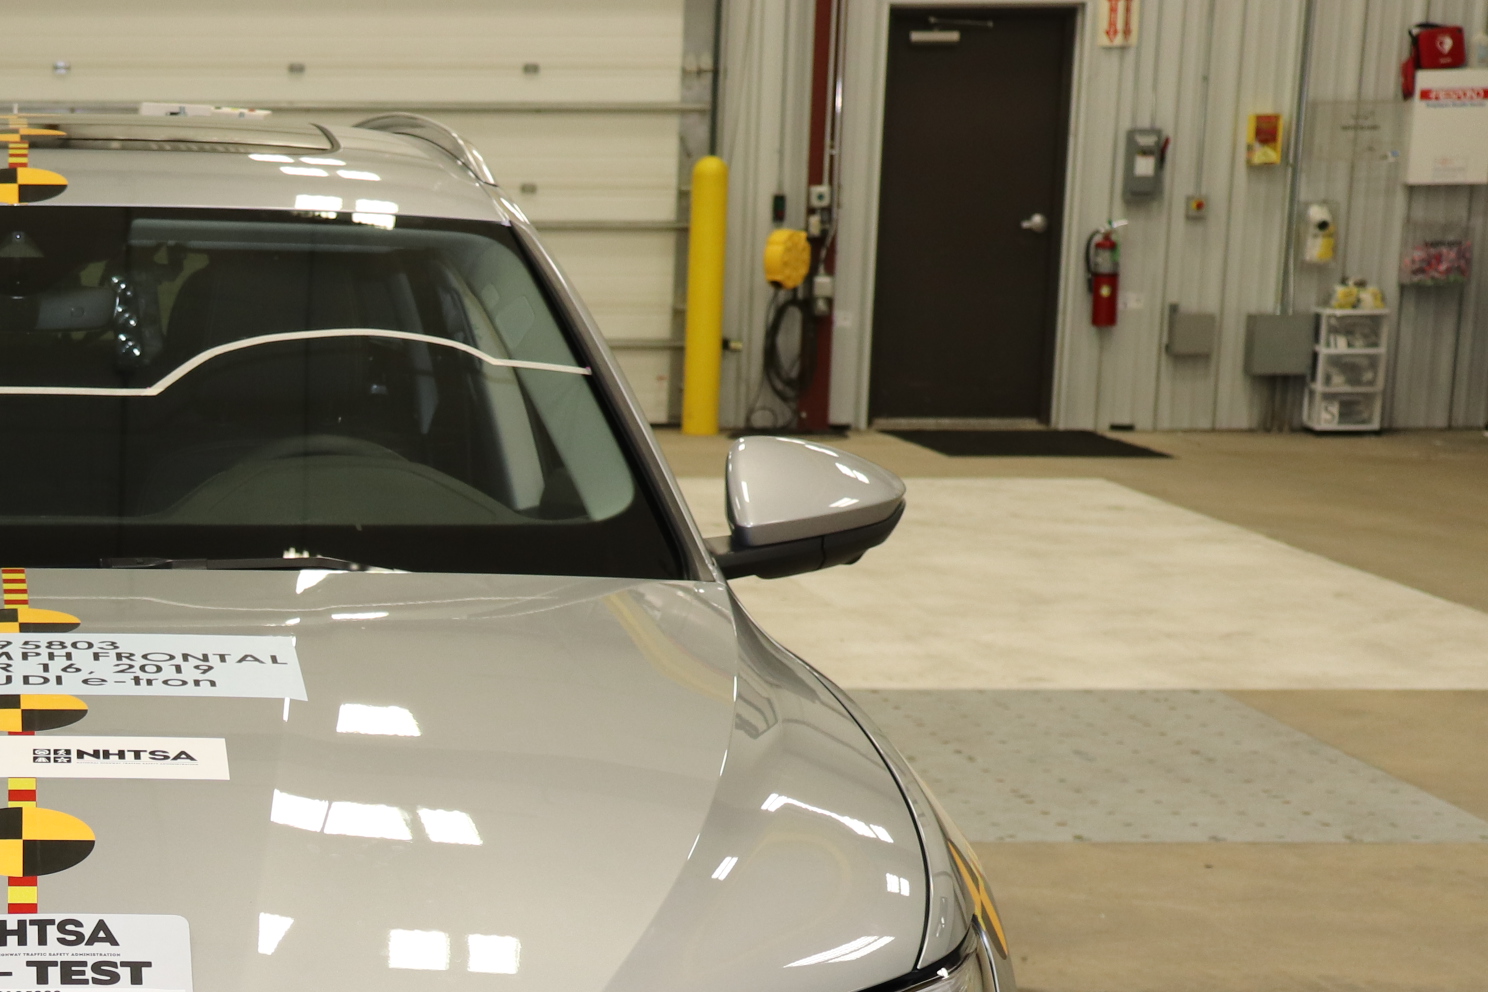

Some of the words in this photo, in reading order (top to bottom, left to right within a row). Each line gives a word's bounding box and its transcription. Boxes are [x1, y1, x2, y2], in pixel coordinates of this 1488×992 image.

[92, 652, 288, 665] FRONTAL
[36, 663, 95, 675] 16,
[112, 663, 215, 674] 2019
[81, 675, 217, 688] e-tron
[76, 749, 197, 762] NHTSA
[26, 961, 152, 985] TEST
